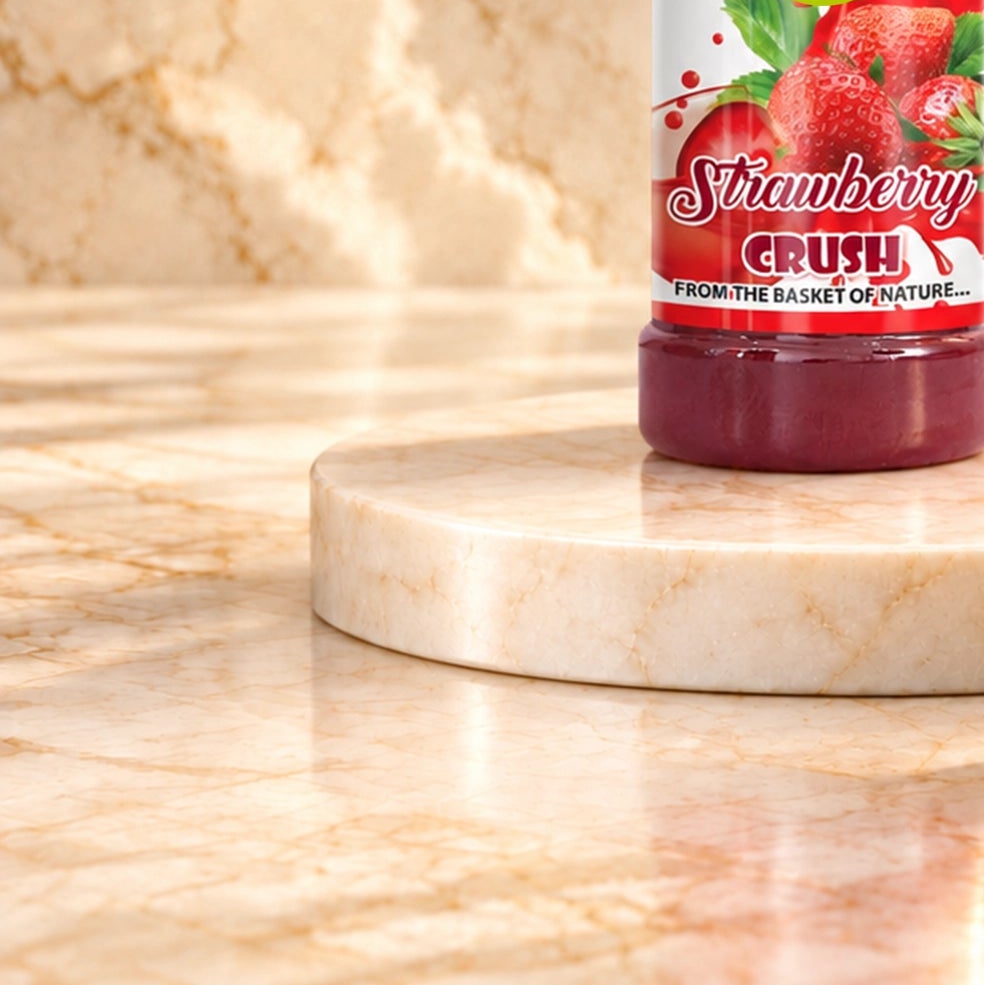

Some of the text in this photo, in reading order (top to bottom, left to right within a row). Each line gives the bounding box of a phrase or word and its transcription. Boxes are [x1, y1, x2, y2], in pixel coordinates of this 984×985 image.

[668, 154, 979, 229] Strawberry
[743, 233, 901, 276] CRUSH
[674, 281, 971, 304] FROM THE BASKET OF NATURE...
